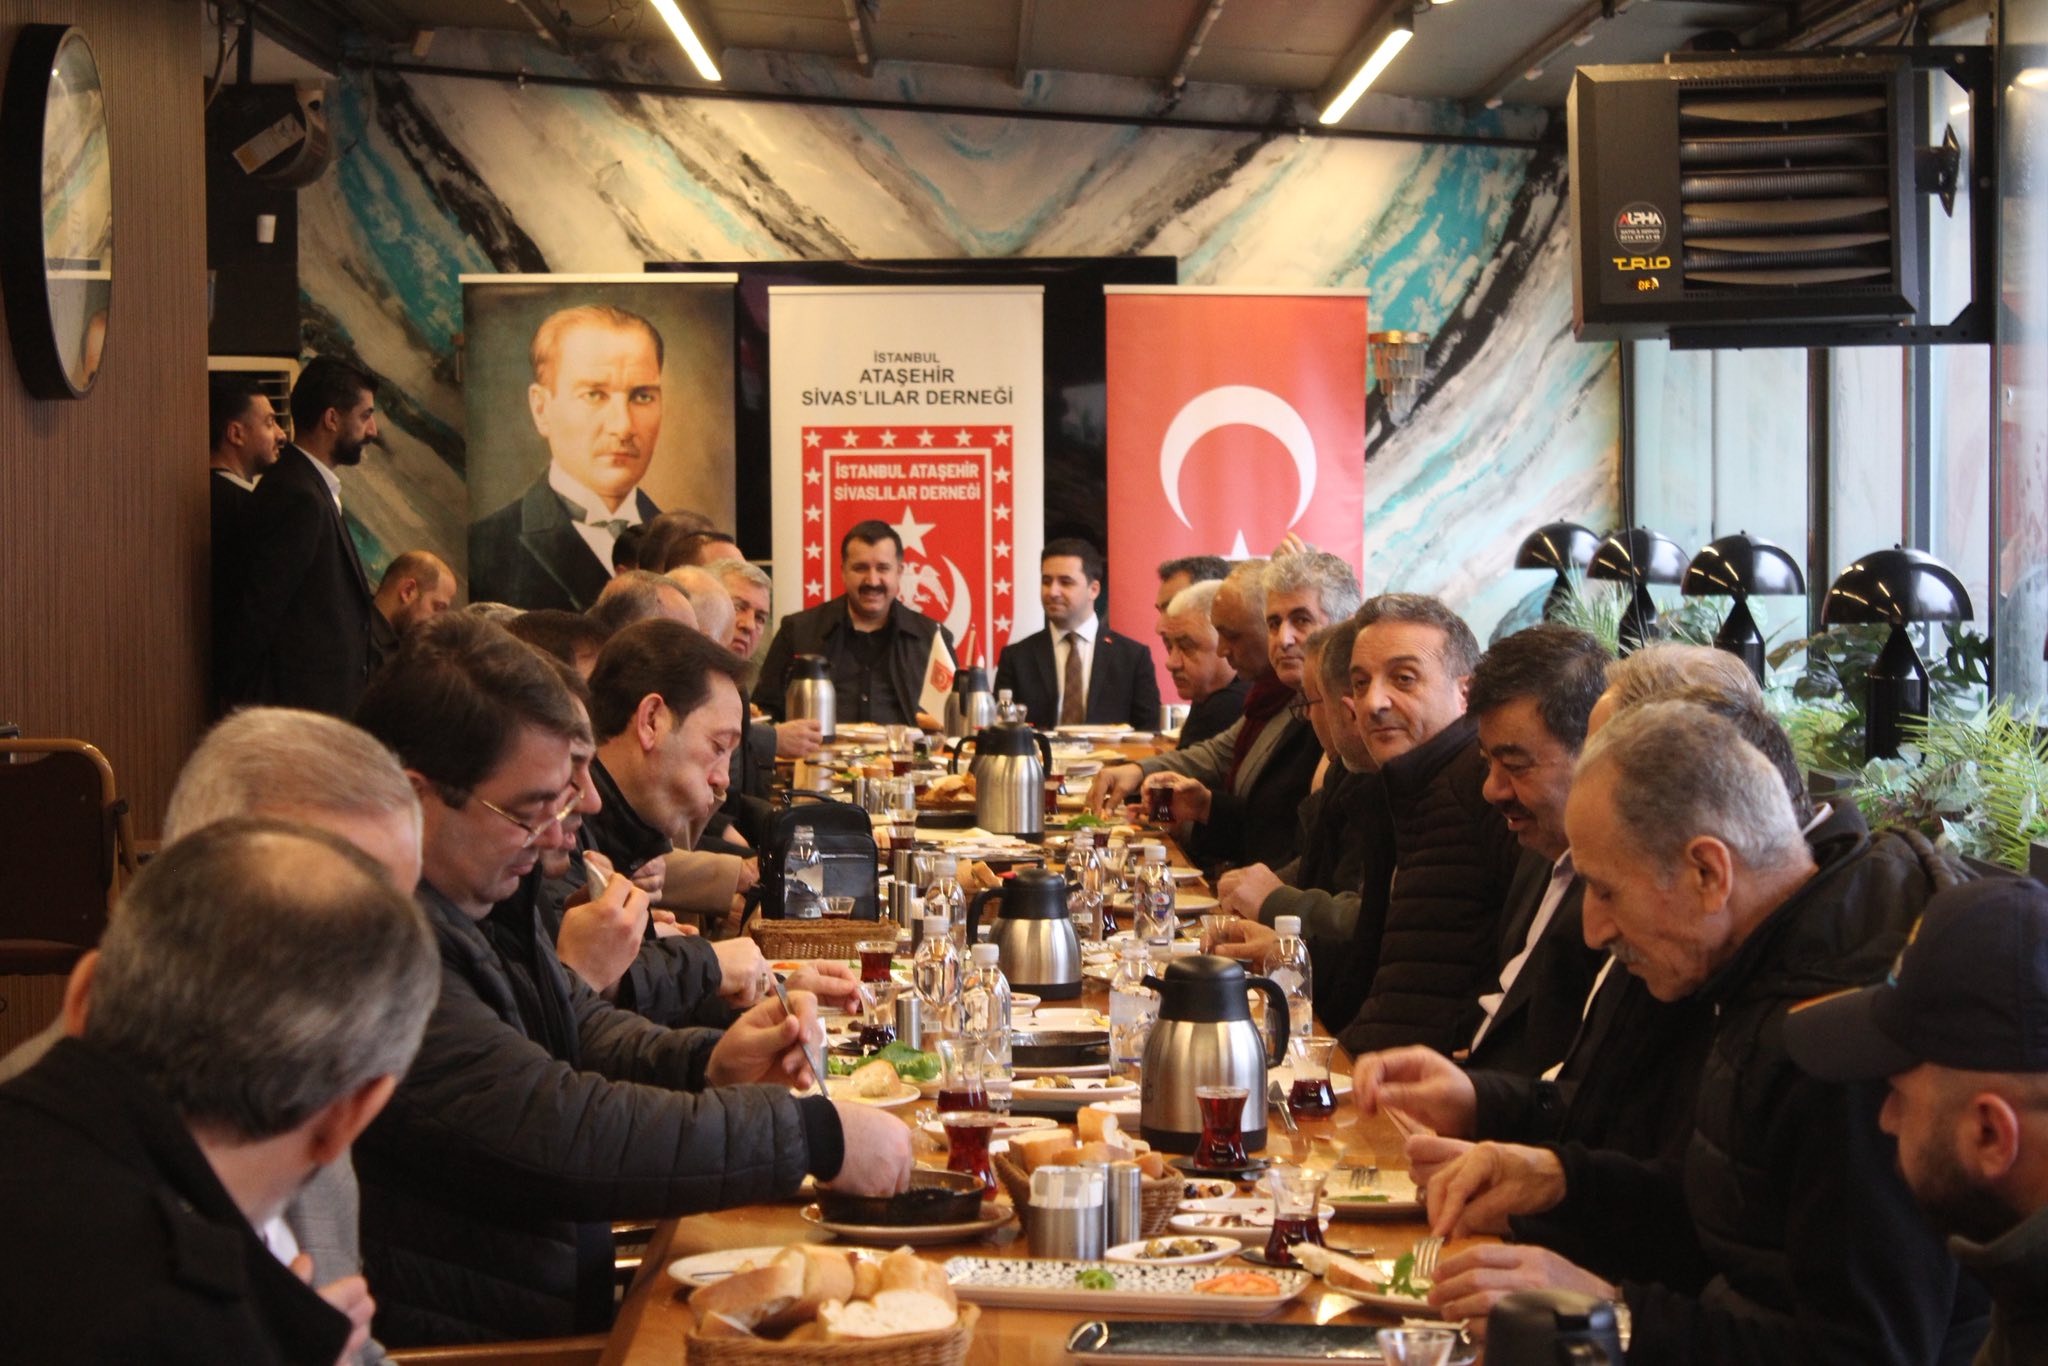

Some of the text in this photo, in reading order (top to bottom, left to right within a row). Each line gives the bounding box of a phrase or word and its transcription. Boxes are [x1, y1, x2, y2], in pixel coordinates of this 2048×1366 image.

[1618, 212, 1662, 225] ALPHA
[1613, 256, 1671, 270] TRIO
[874, 351, 940, 363] İSTANBUL
[860, 366, 954, 386] ATAŞEHİR
[802, 386, 1013, 405] SİVAS'LILAR DERNEĞİ
[835, 461, 979, 481] İSTANBUL ATAŞEHİR
[834, 482, 980, 501] SİVASLILAR DERNEĞİ
